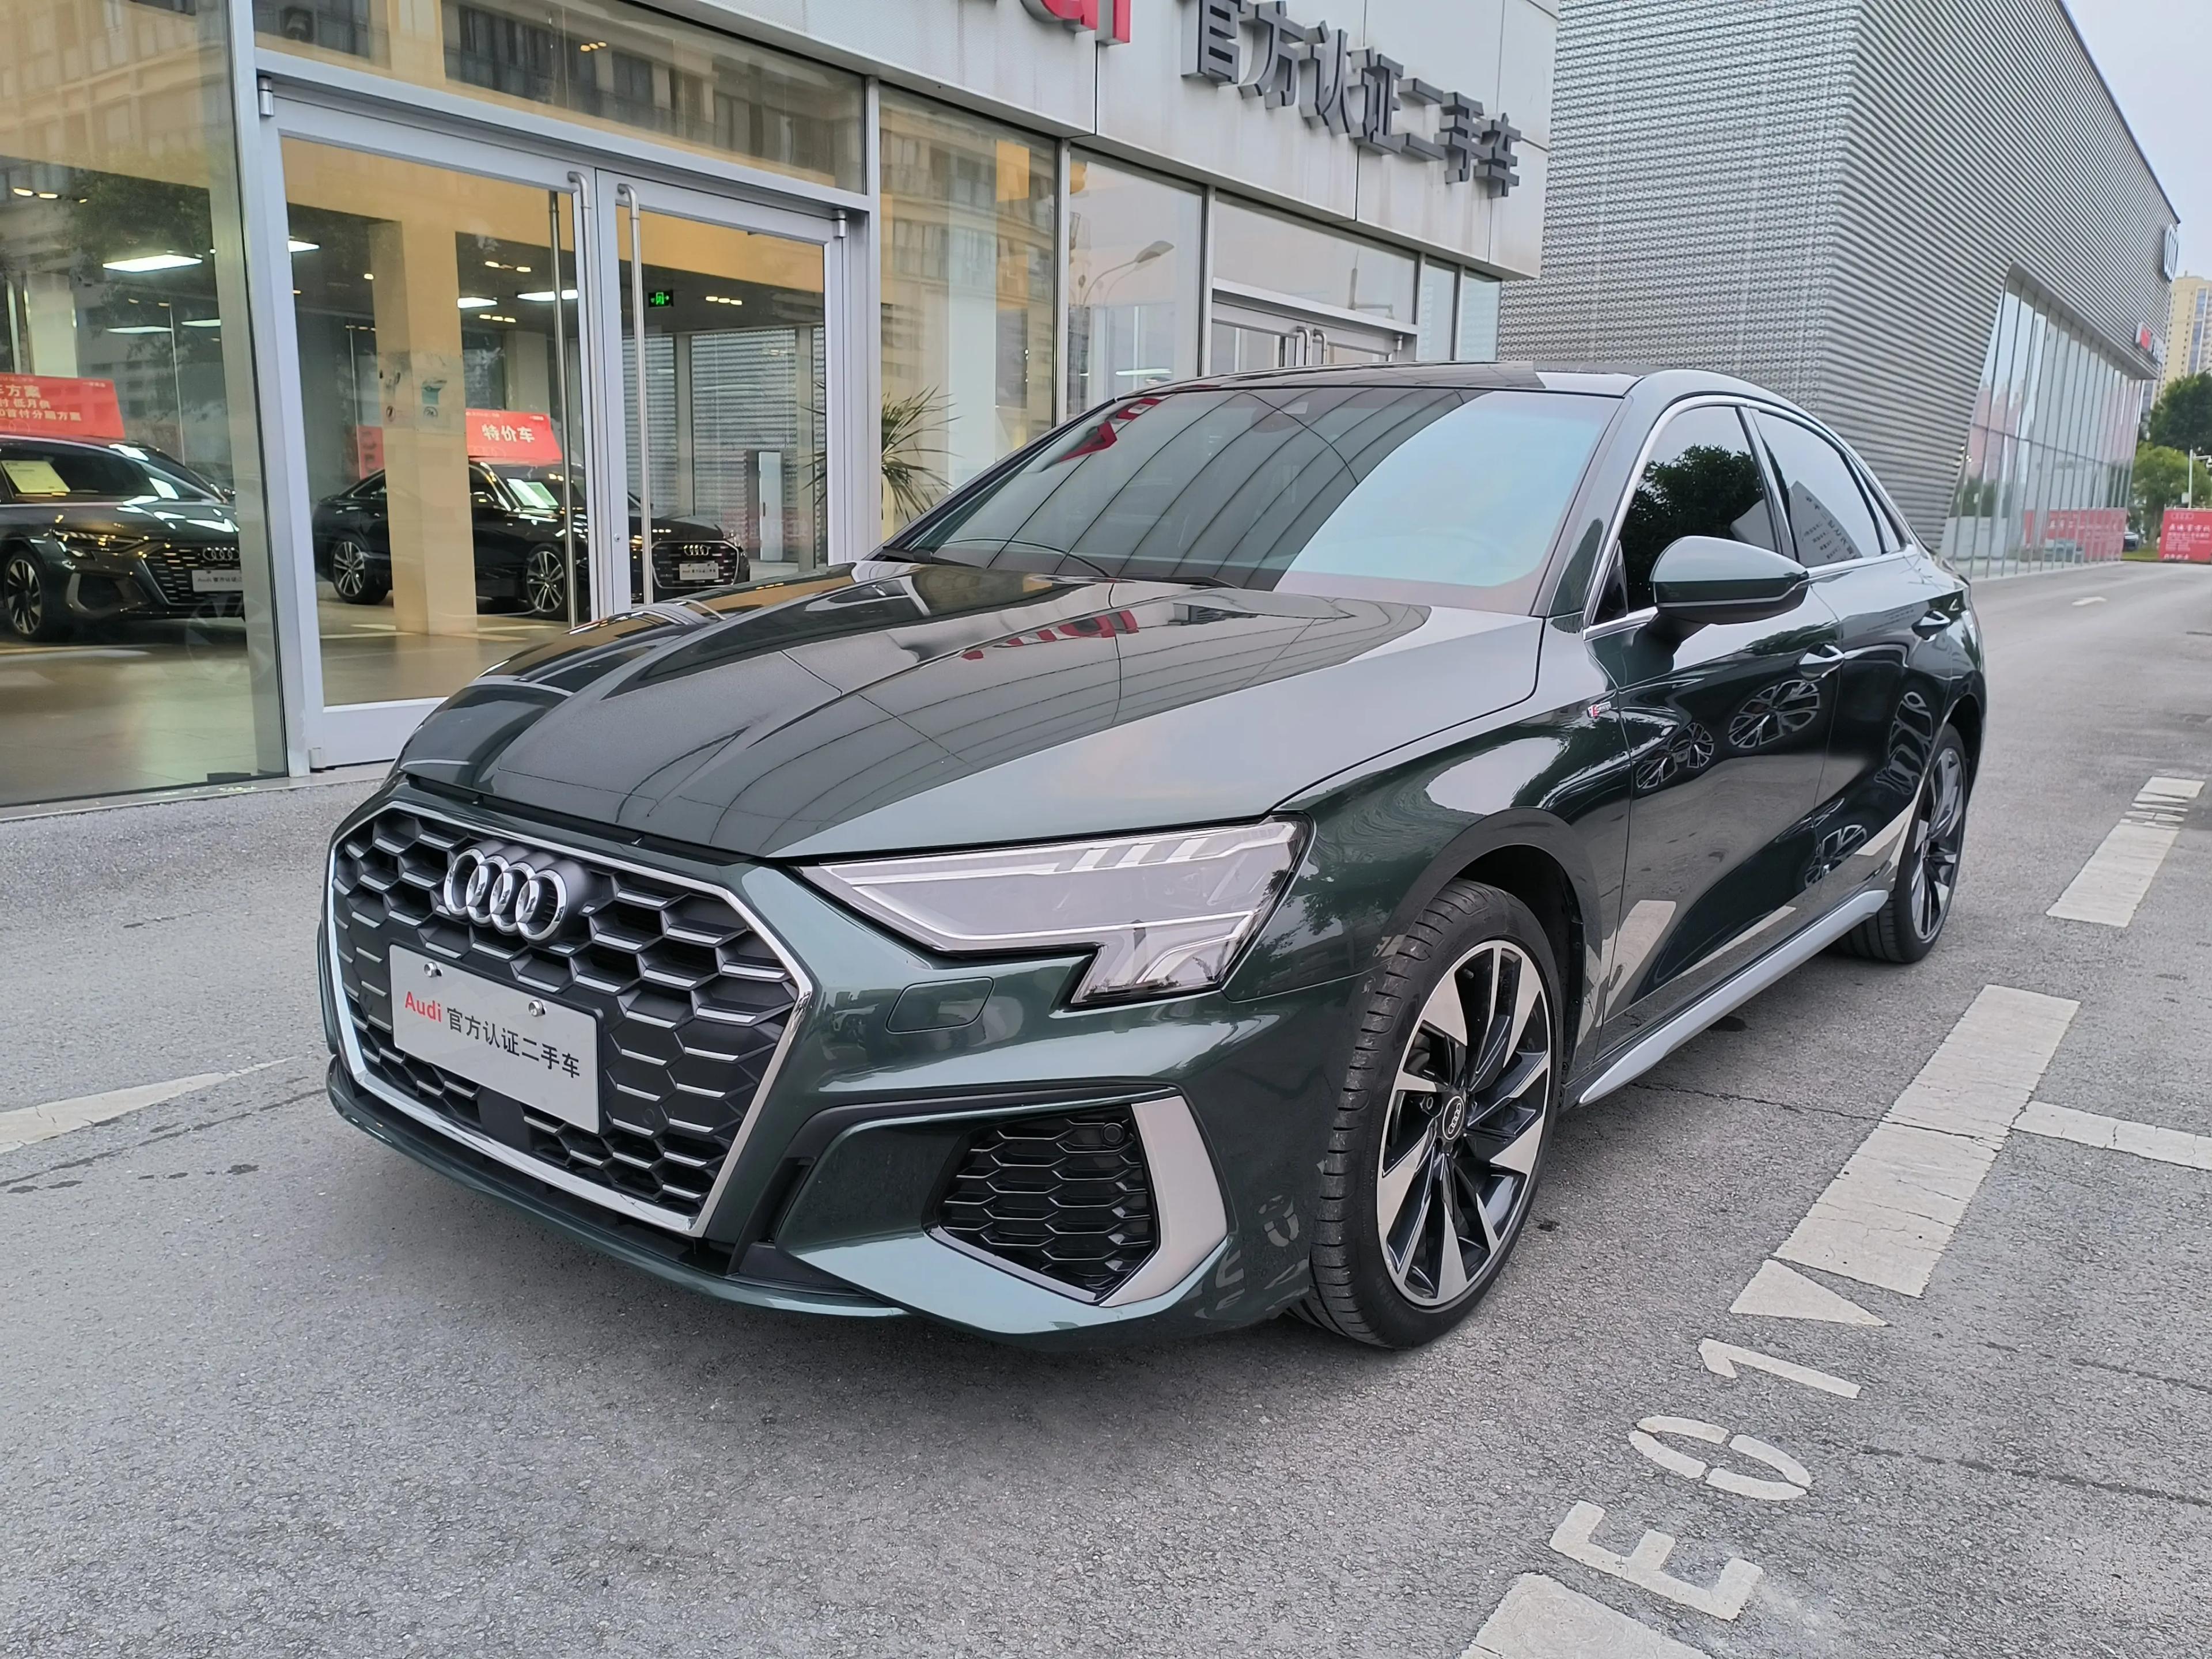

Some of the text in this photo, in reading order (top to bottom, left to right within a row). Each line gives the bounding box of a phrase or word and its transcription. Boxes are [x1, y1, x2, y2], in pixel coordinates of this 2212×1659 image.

[482, 424, 535, 443] 特价车
[405, 991, 580, 1078] Audi 官方认证二手车
[1550, 1338, 1862, 1621] E01
